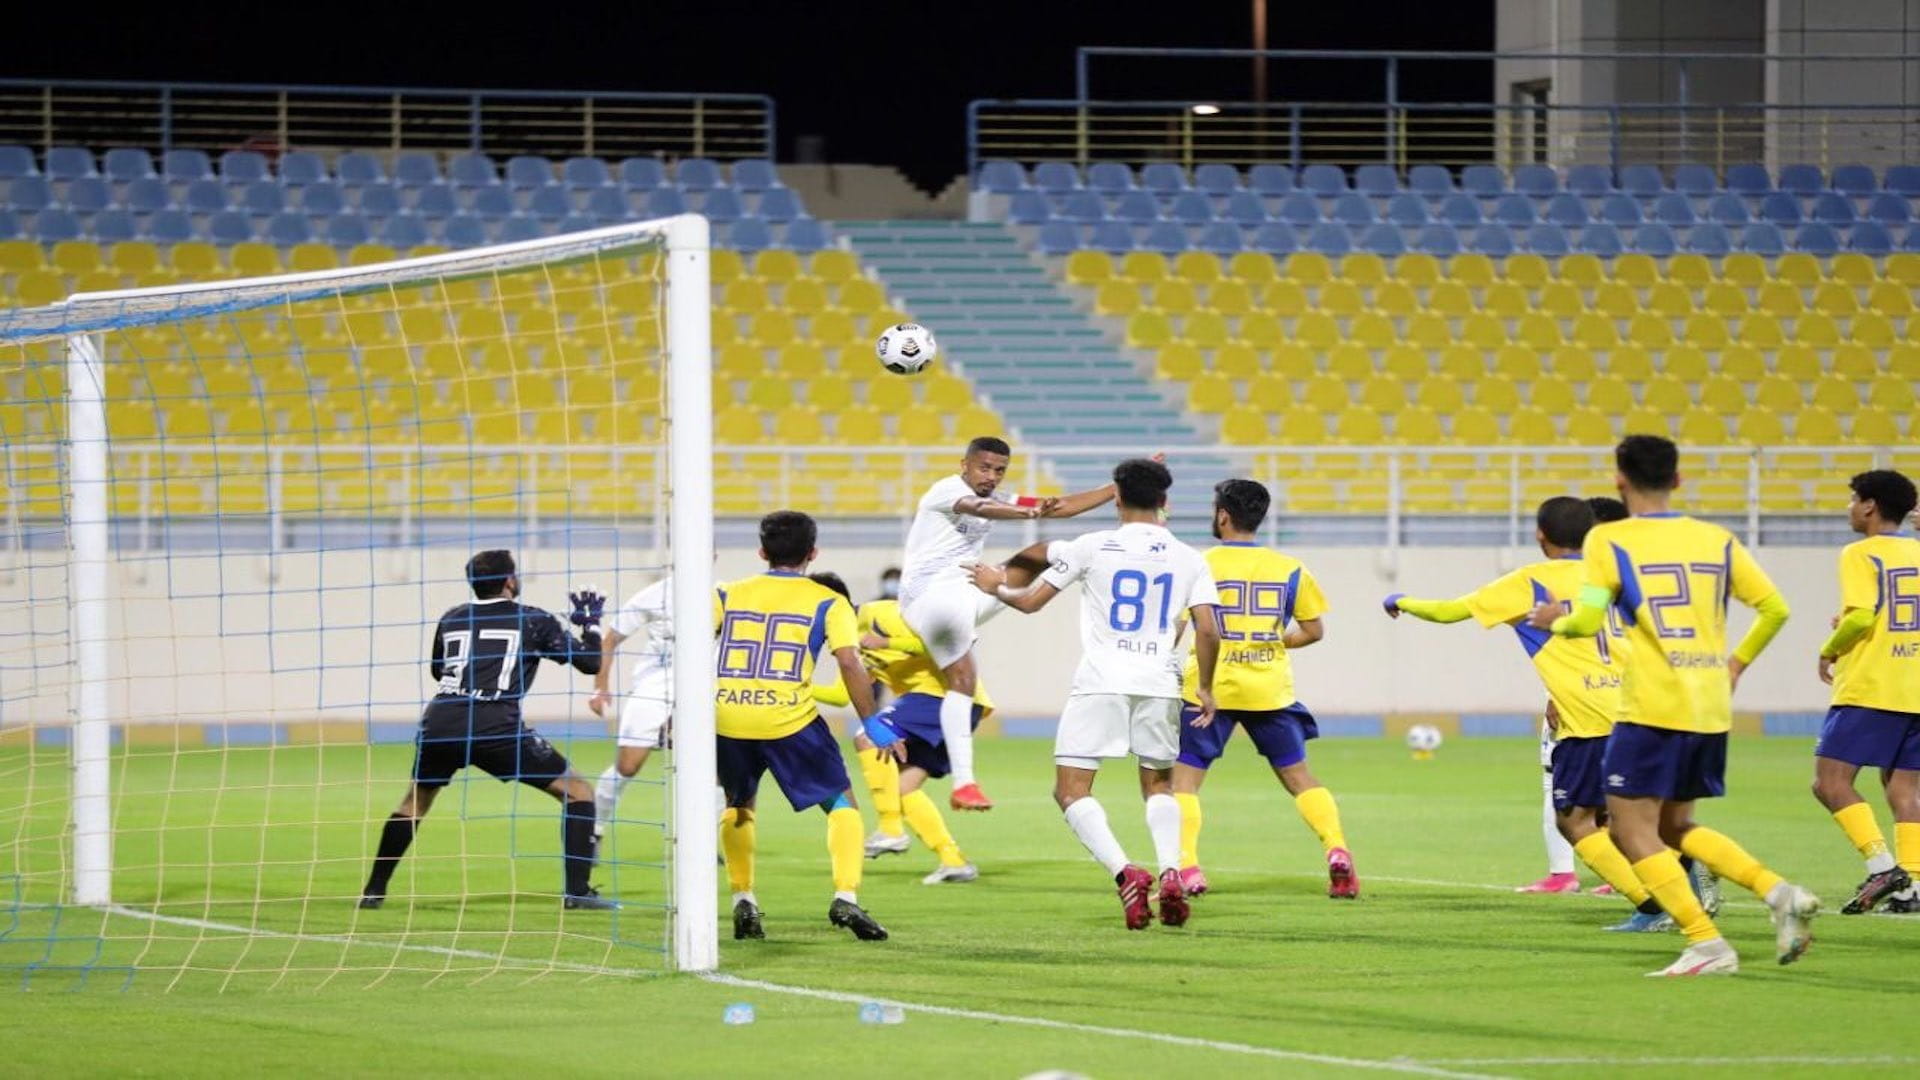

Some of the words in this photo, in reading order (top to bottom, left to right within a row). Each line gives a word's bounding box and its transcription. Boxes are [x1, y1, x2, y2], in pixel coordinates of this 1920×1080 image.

[1110, 569, 1173, 634] 81
[1214, 580, 1288, 640] 29
[1640, 563, 1725, 638] 27
[1887, 567, 1920, 631] 6
[717, 610, 812, 682] 66
[715, 688, 798, 705] FARES.J
